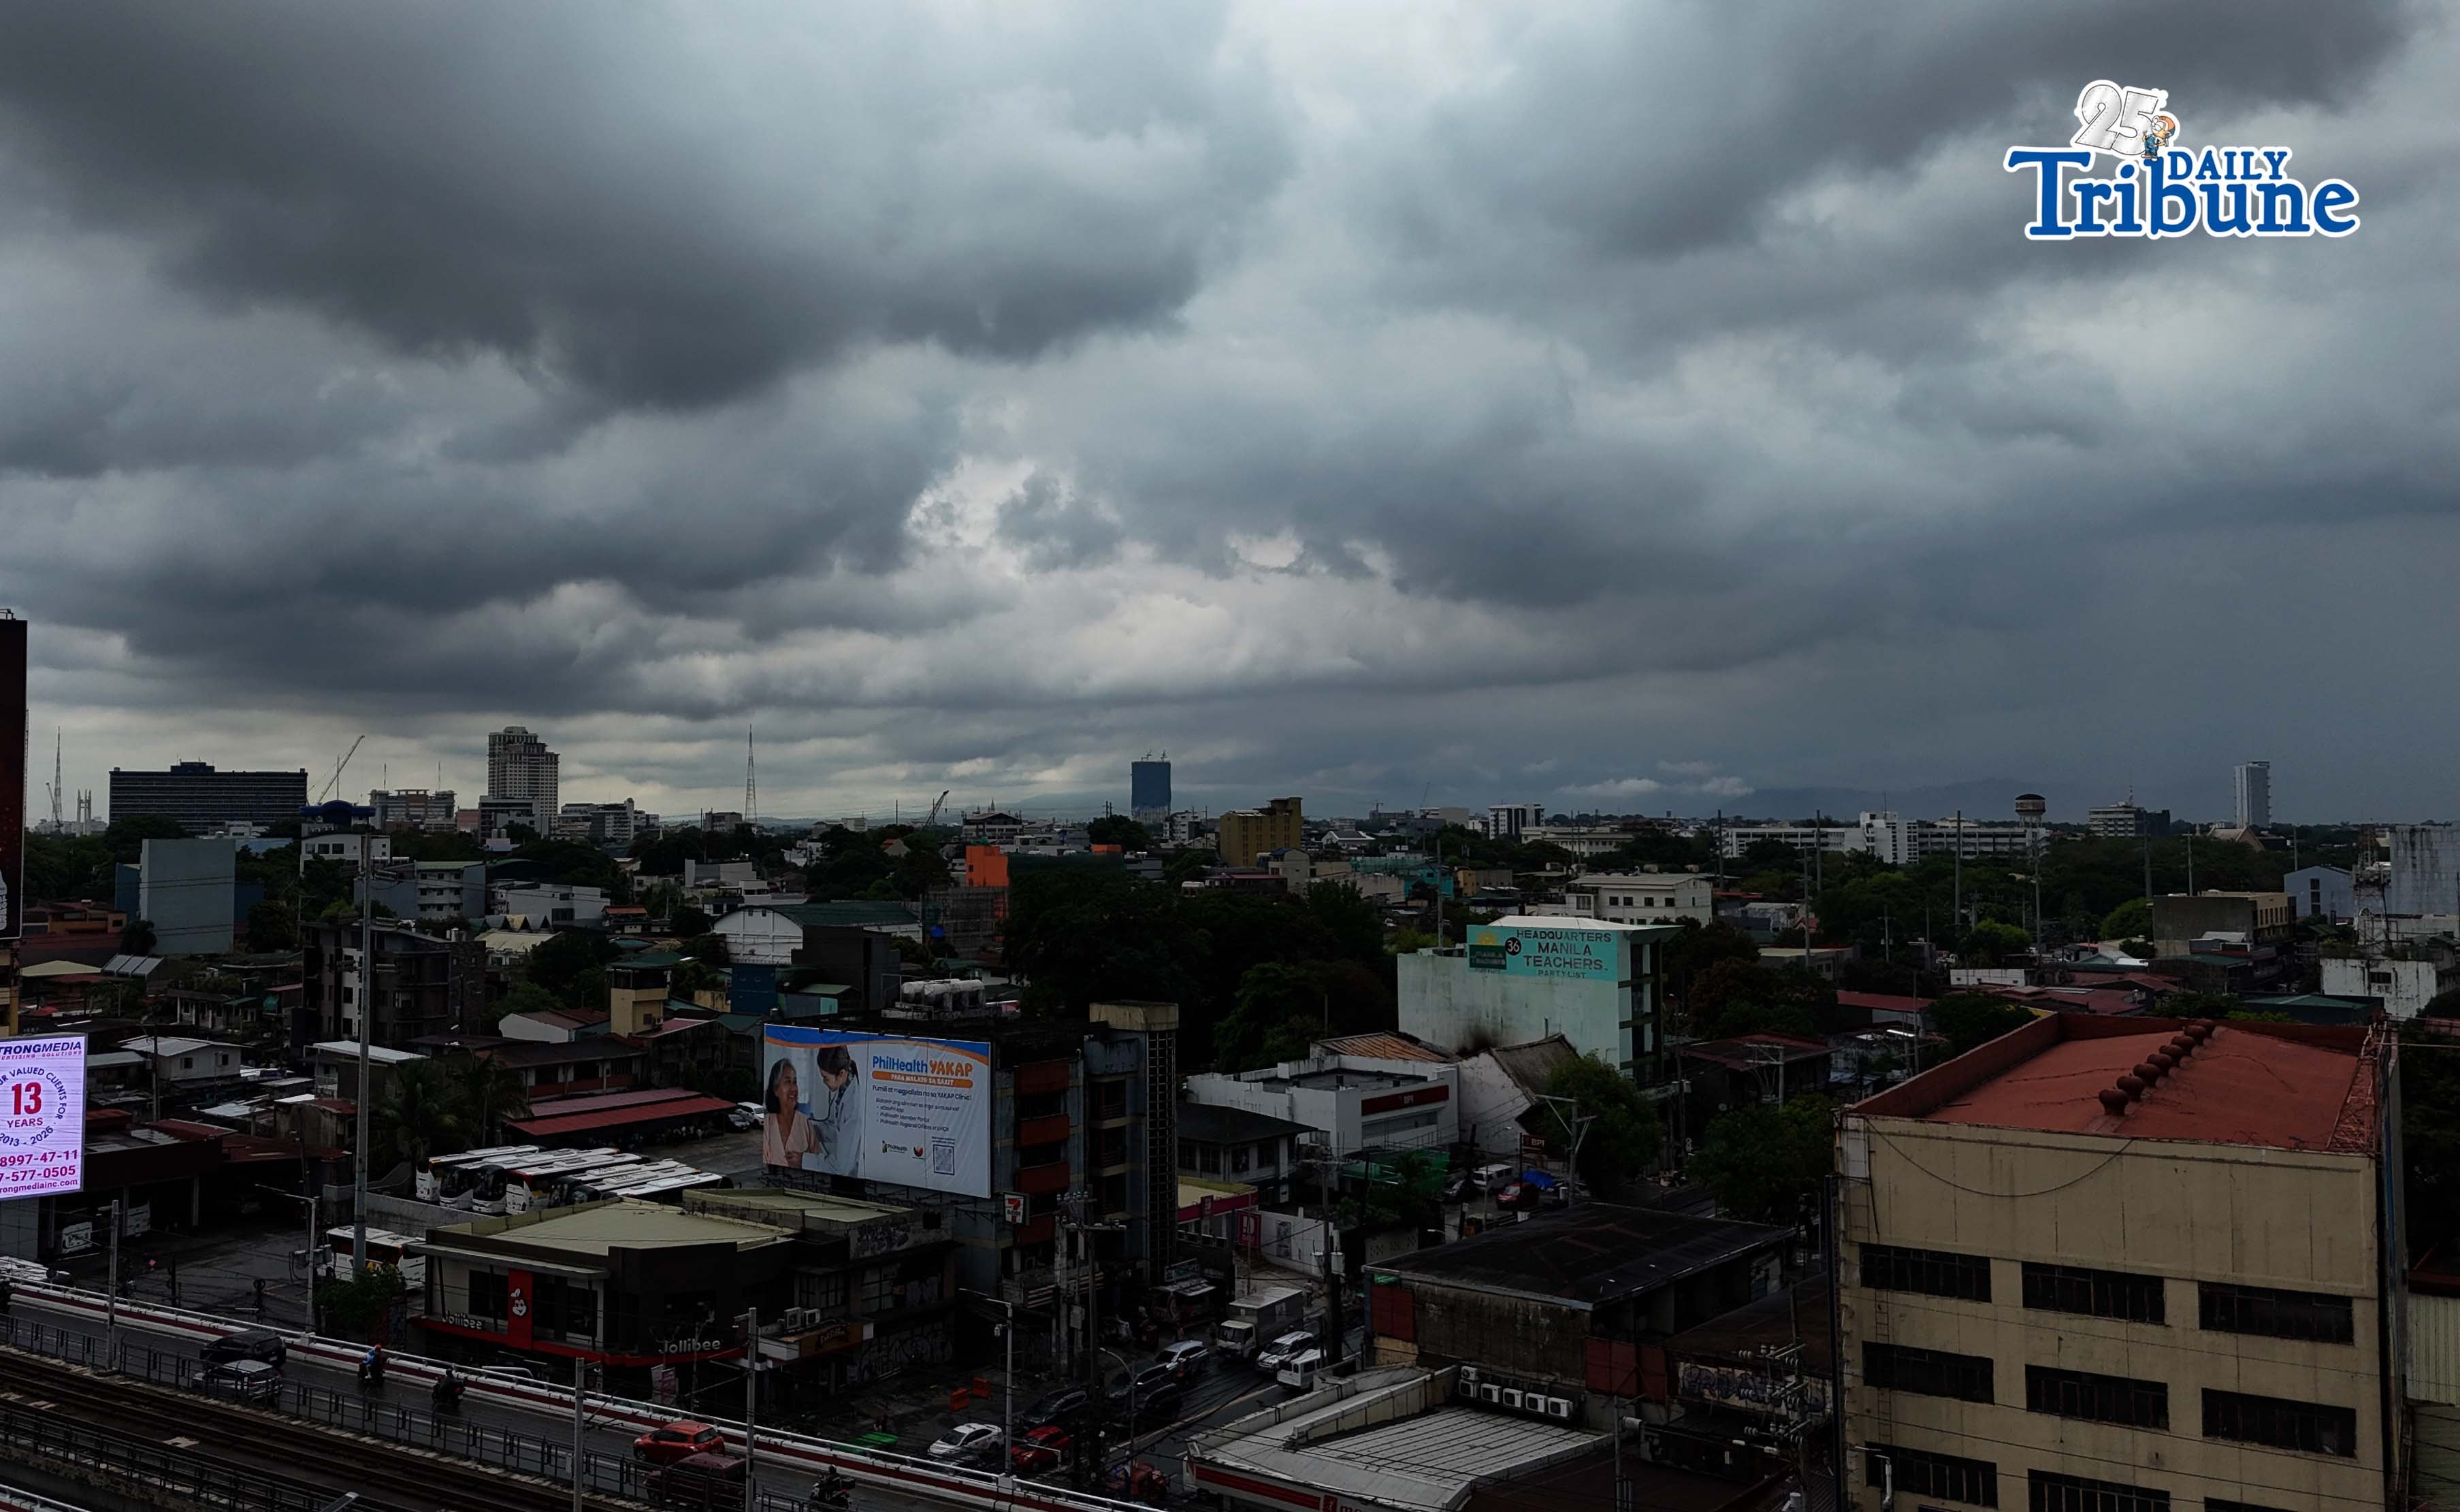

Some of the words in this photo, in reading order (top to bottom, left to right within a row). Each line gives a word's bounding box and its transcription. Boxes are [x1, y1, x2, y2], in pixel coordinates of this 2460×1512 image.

[1517, 930, 1612, 943] HEADQUARTERS
[1506, 940, 1521, 952] 36
[1538, 942, 1592, 956] MANILA
[9, 1066, 44, 1077] VALUED
[873, 1055, 928, 1073] PhilHealth
[929, 1059, 973, 1077] YAKAP
[46, 1072, 67, 1100] CLIENTS
[12, 1082, 42, 1115] 13
[54, 1102, 67, 1119] FOR
[7, 1117, 43, 1128] YEARS
[0, 1133, 20, 1147] 2013
[30, 1125, 54, 1145] 2026
[1531, 1138, 1545, 1148] BPI
[887, 1143, 908, 1151] PhilHealth
[0, 1149, 78, 1167] 8997-47-11
[442, 1310, 483, 1330] Jollibee
[658, 1337, 721, 1354] Jollibee
